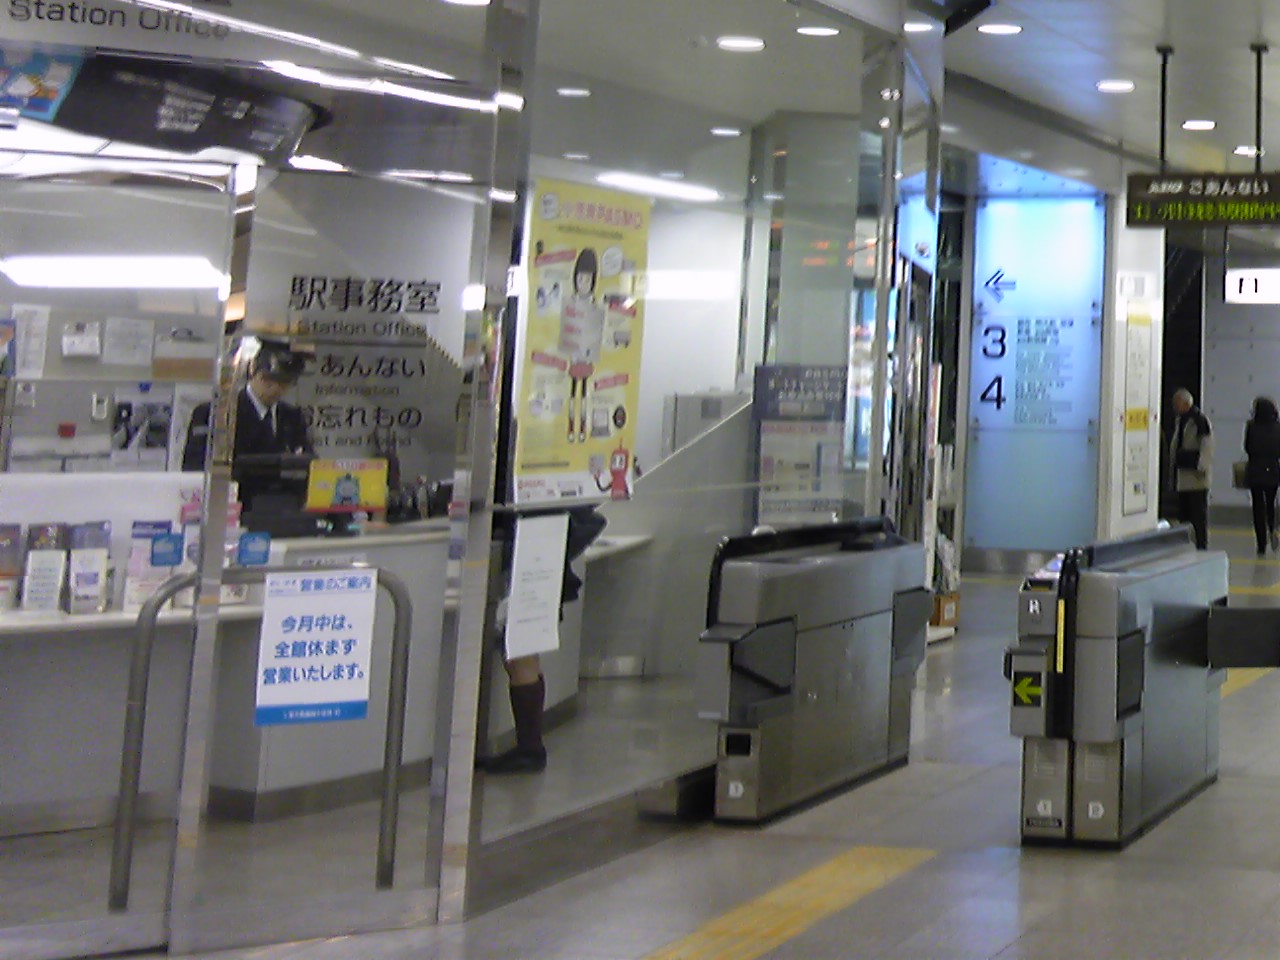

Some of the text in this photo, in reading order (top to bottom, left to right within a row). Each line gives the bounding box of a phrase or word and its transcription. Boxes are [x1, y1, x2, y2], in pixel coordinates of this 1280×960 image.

[289, 274, 441, 314] 駅事務室
[982, 325, 1007, 359] 3
[979, 374, 1007, 411] 4
[274, 639, 358, 660] 全館休まず
[262, 663, 365, 686] 営業いたします。
